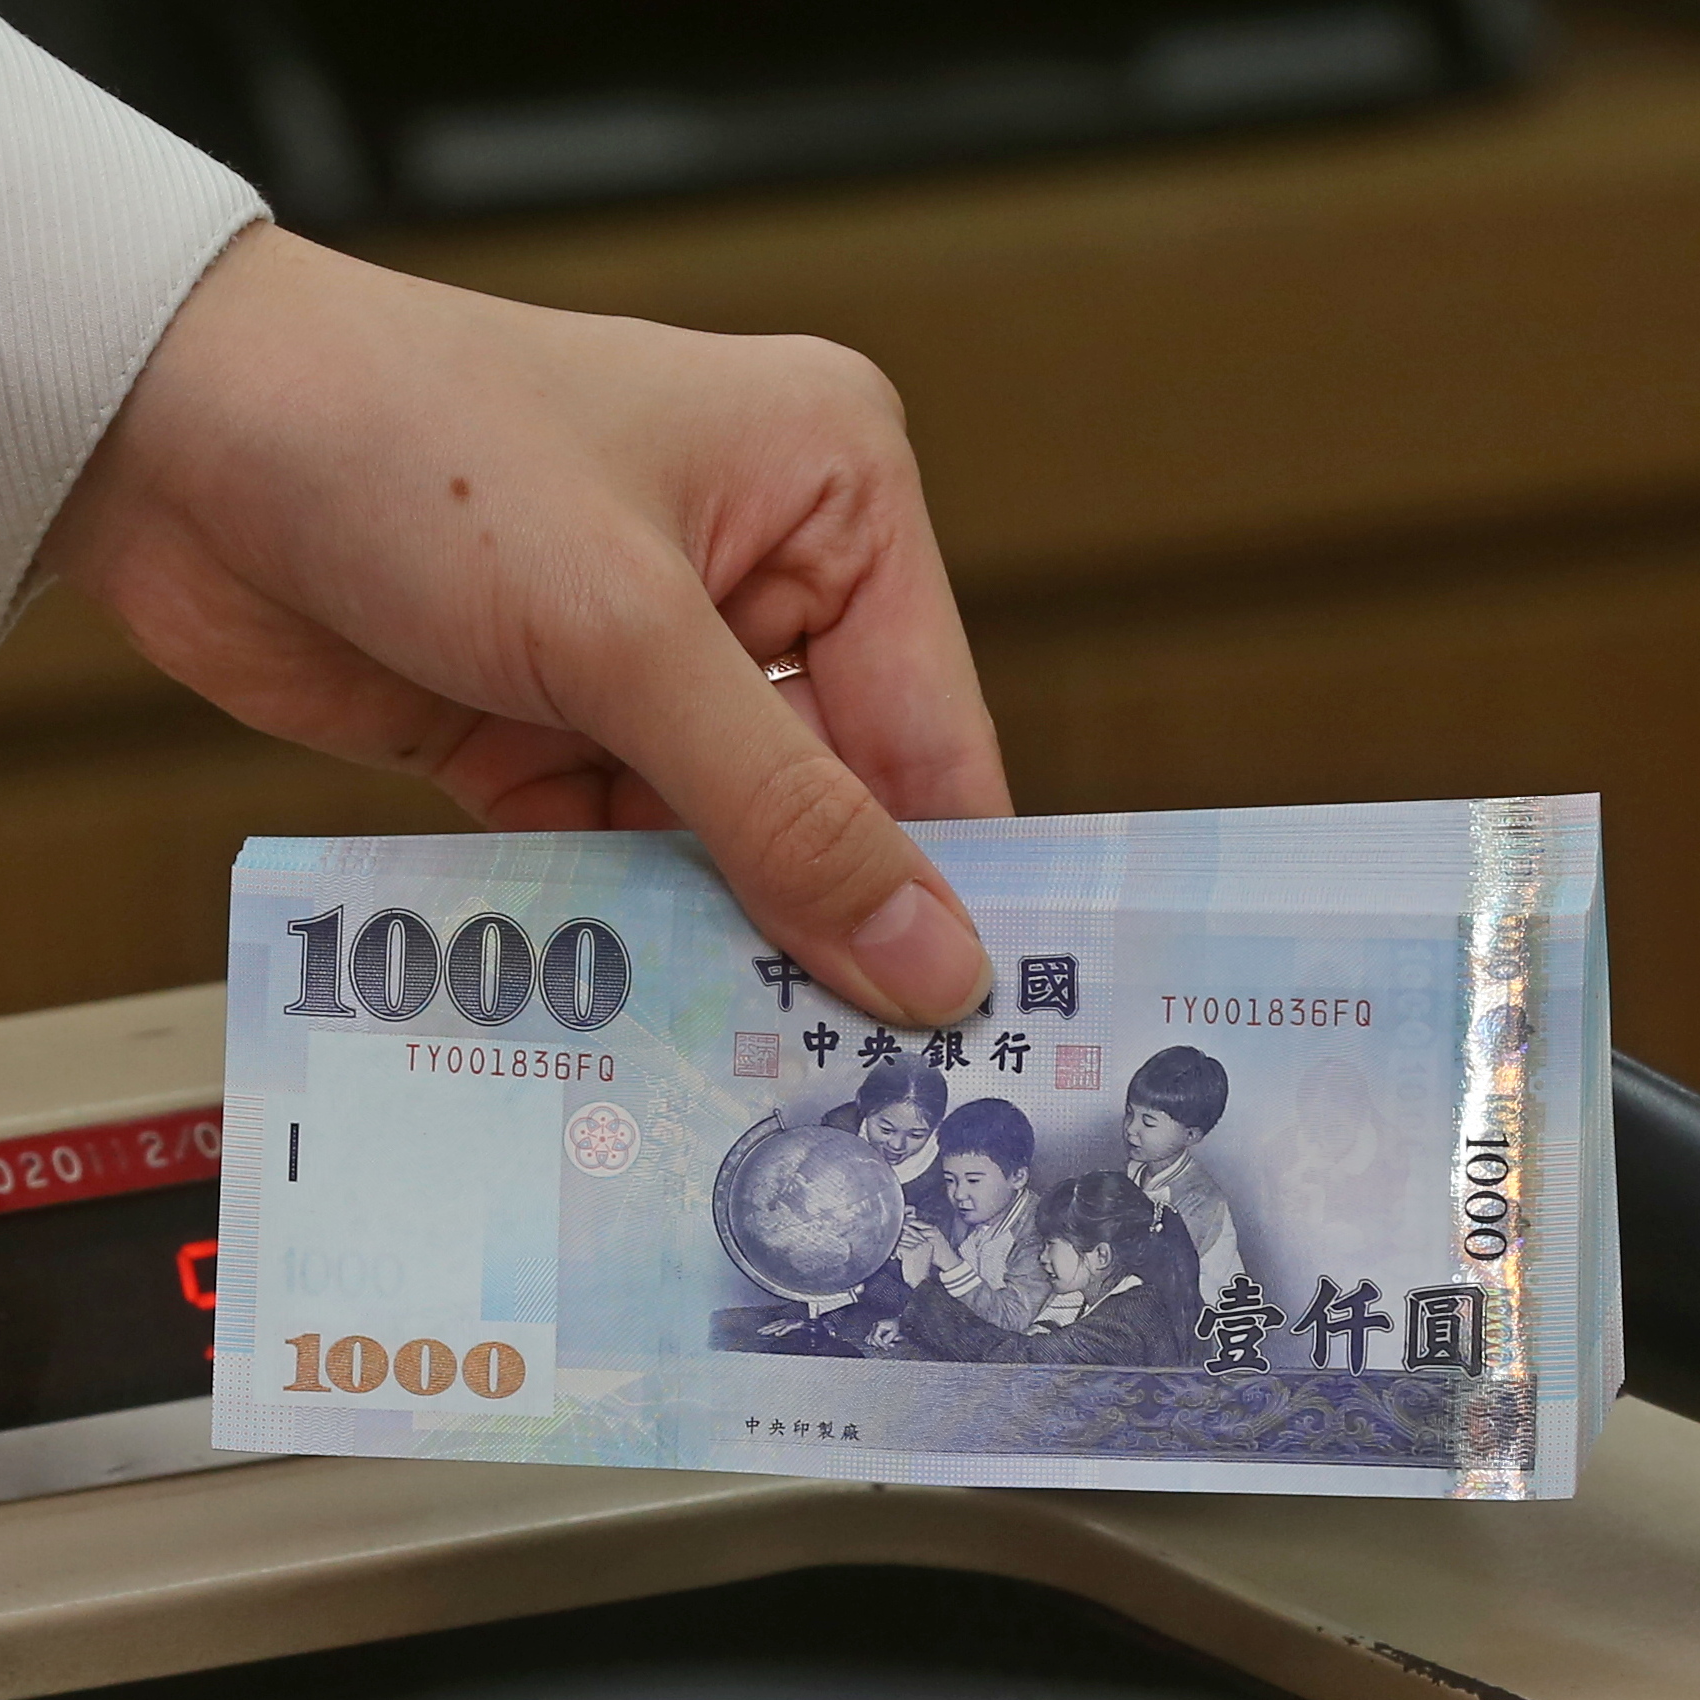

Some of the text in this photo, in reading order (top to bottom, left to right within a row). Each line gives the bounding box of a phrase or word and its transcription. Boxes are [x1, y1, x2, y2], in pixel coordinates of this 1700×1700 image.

[284, 905, 631, 1031] 1000
[1162, 996, 1373, 1029] TY001836FQ
[406, 1043, 615, 1084] TY001836FQ
[802, 1021, 1032, 1074] 中央銀行
[1464, 1133, 1511, 1261] 1000
[1196, 1275, 1488, 1378] 壹仟圓
[283, 1332, 526, 1400] 1000
[745, 1416, 860, 1441] 中央印製廠
